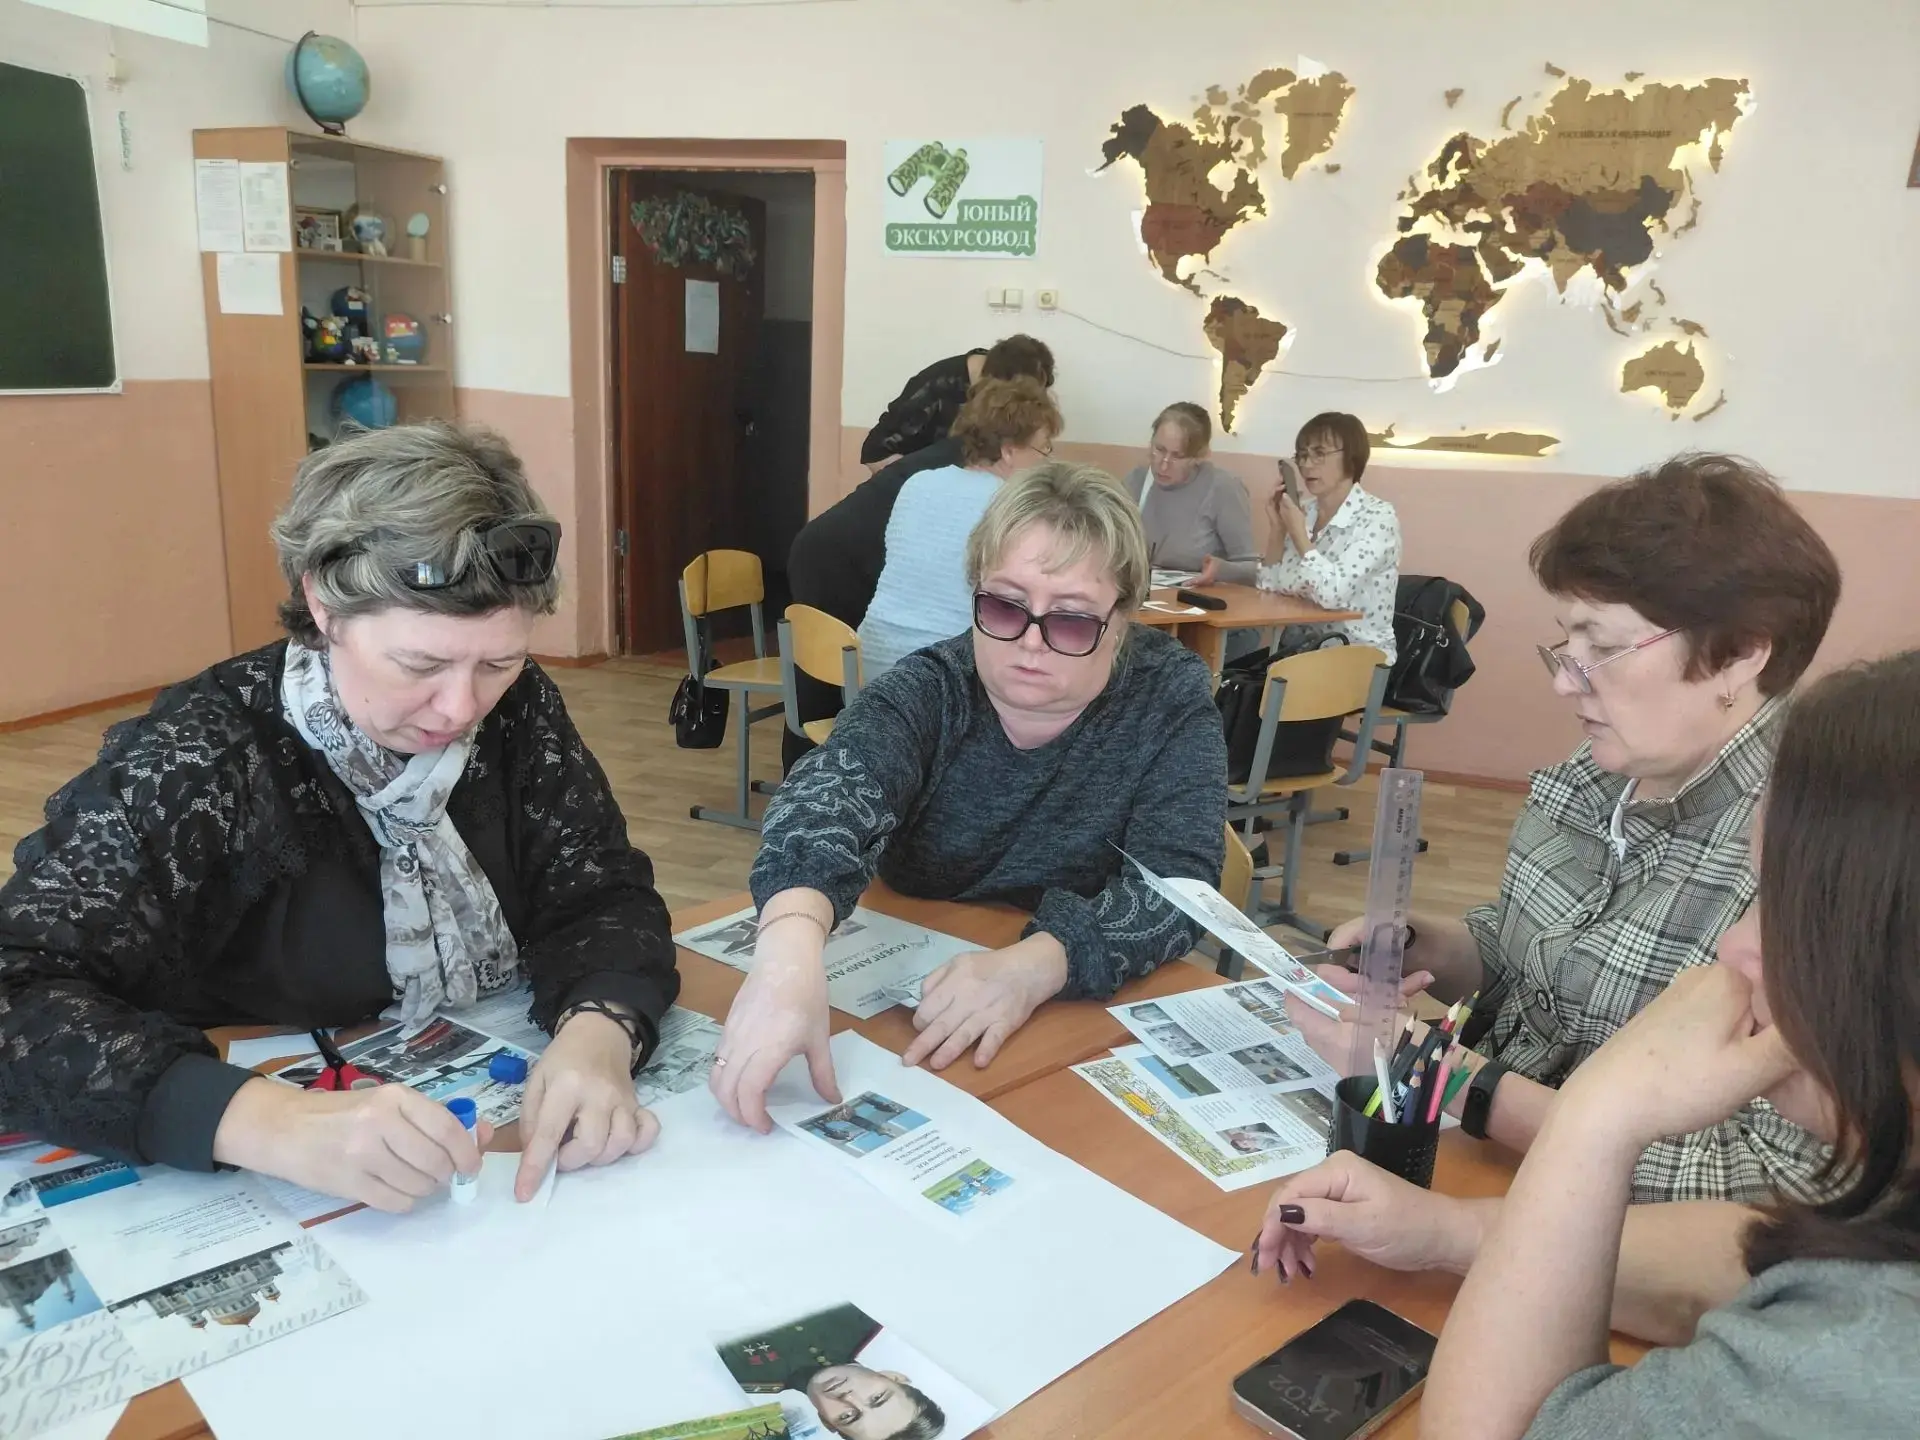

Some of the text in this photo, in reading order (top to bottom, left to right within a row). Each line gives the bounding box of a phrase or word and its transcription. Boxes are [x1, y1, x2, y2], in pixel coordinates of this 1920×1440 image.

[963, 202, 1031, 221] ЮНЫЙ
[890, 229, 1030, 249] ЭКСКУРСОВОД
[1269, 1374, 1341, 1424] 14:02
